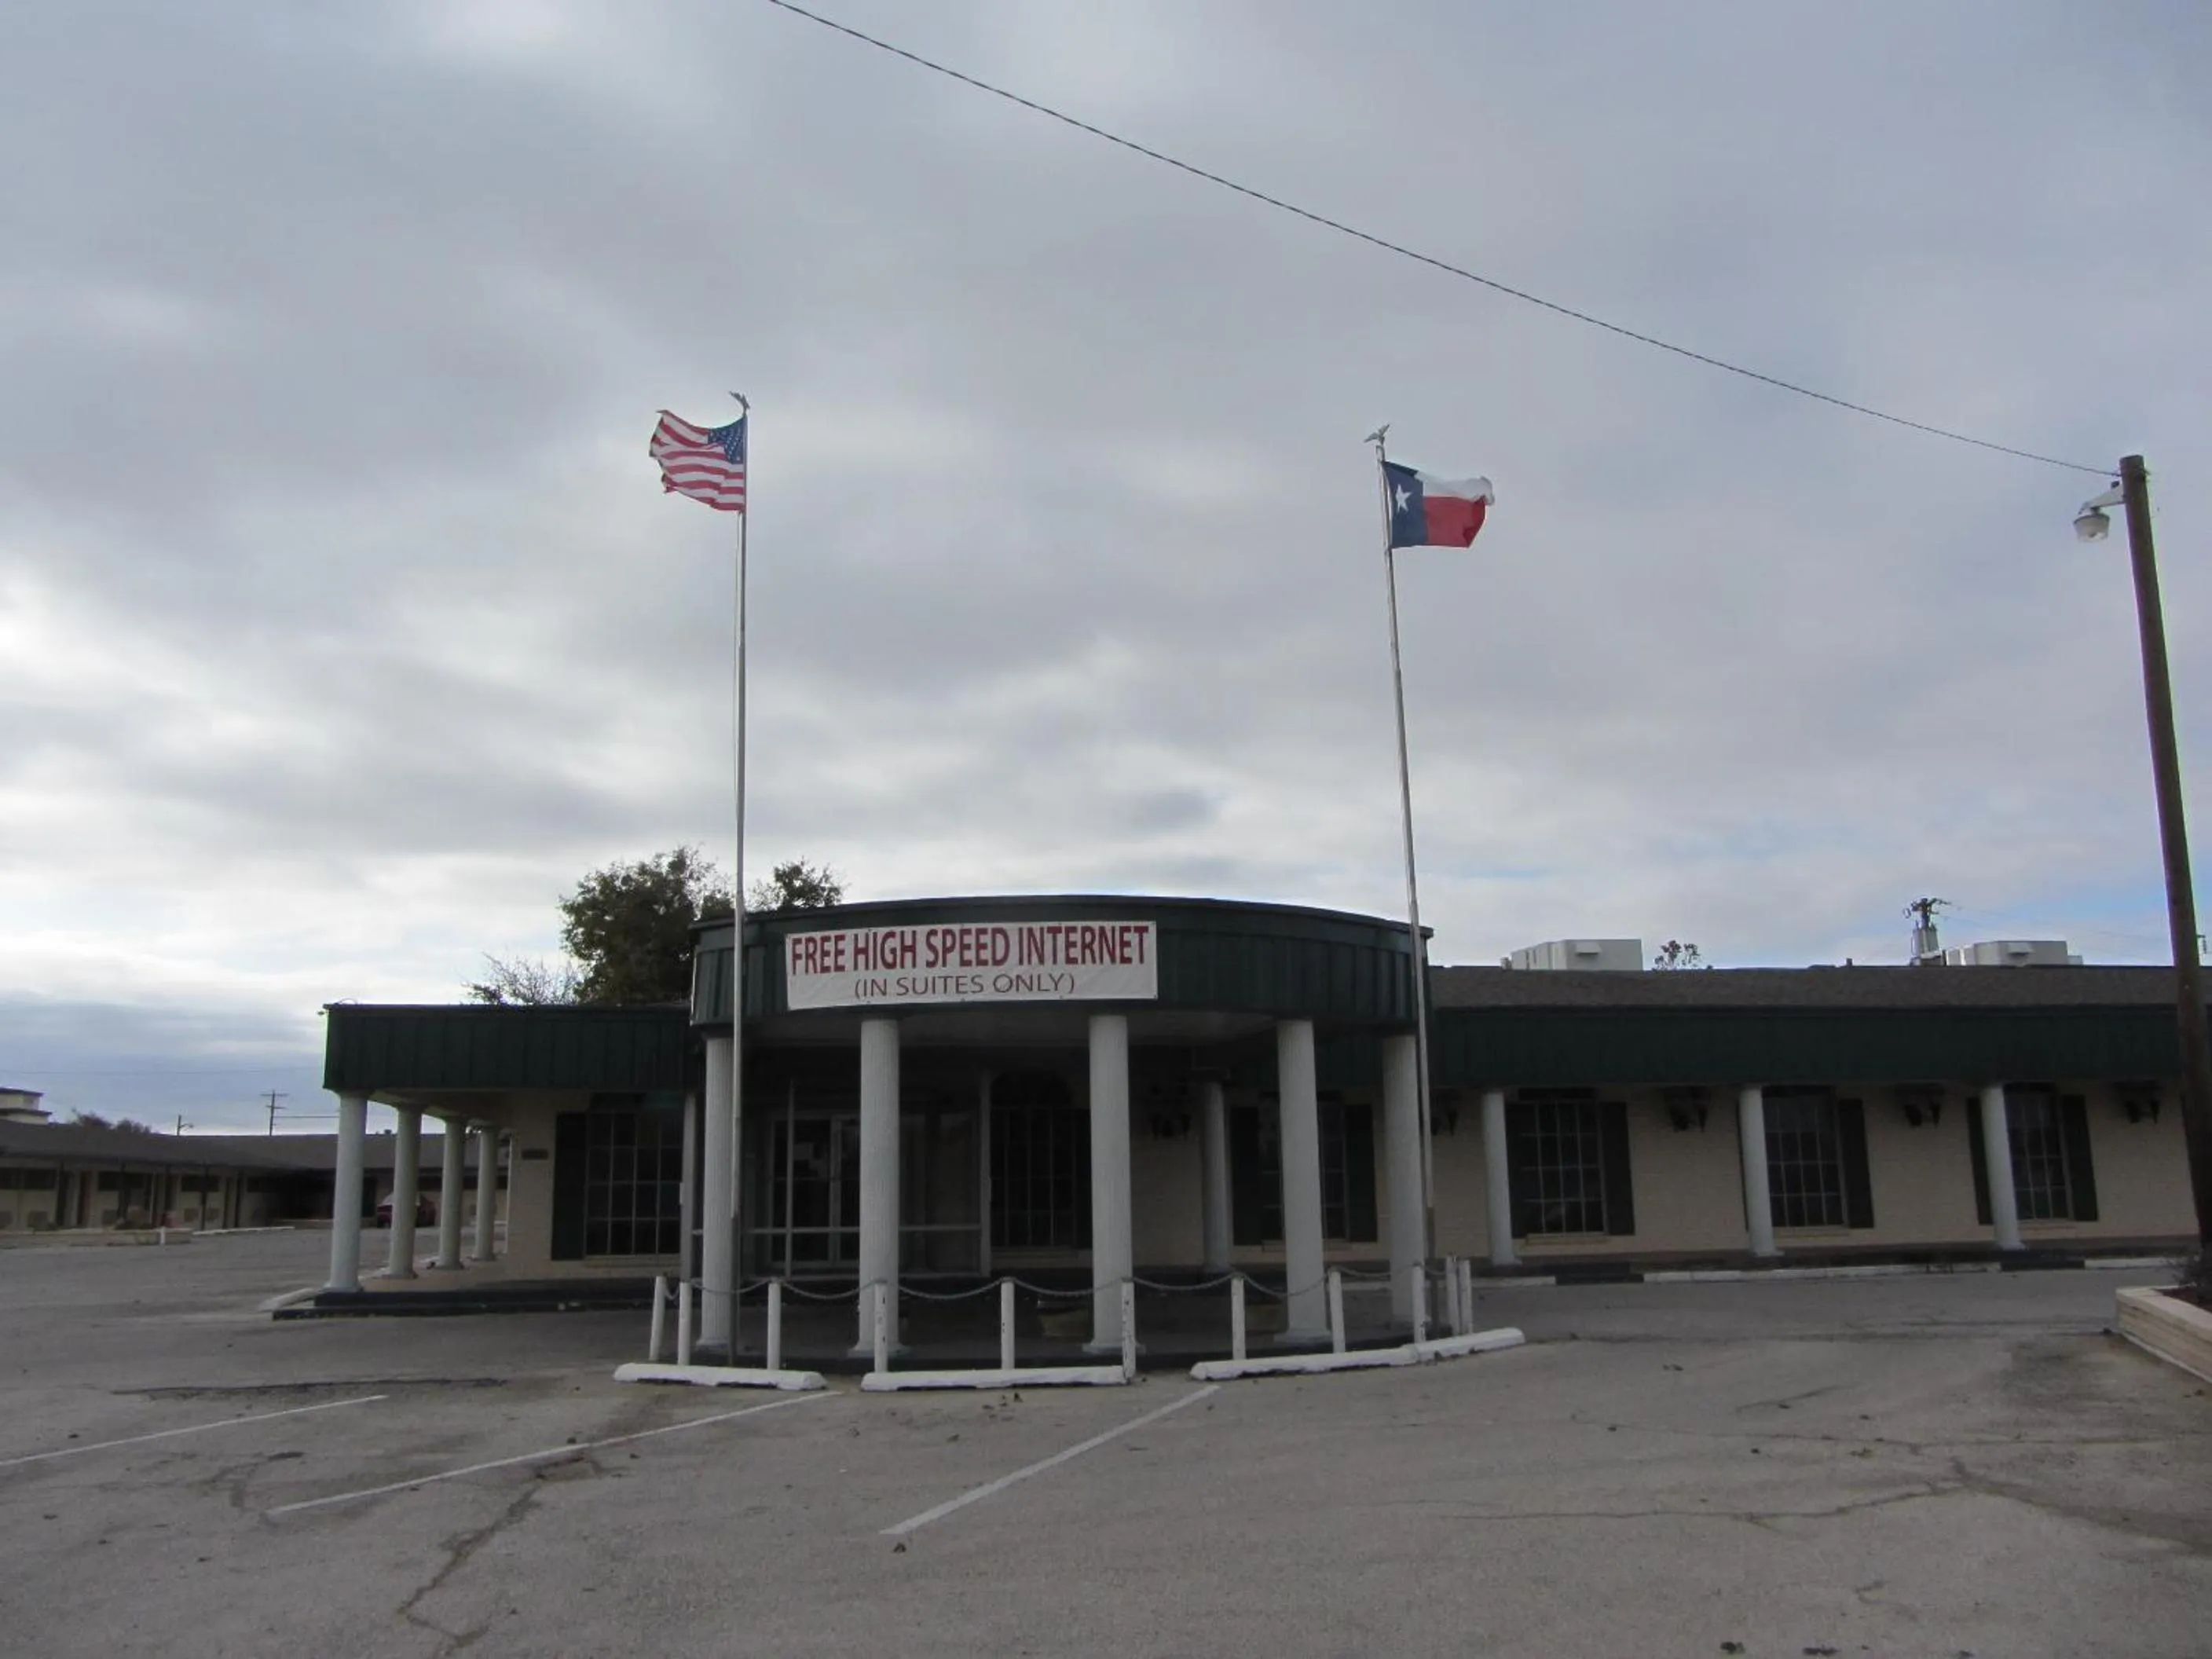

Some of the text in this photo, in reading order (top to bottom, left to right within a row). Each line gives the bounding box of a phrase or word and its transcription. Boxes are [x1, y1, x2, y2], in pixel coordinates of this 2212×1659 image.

[792, 925, 1149, 975] FREE HIGH SPEED INTERNET
[855, 972, 1075, 999] (IN SUITES ONLY)
